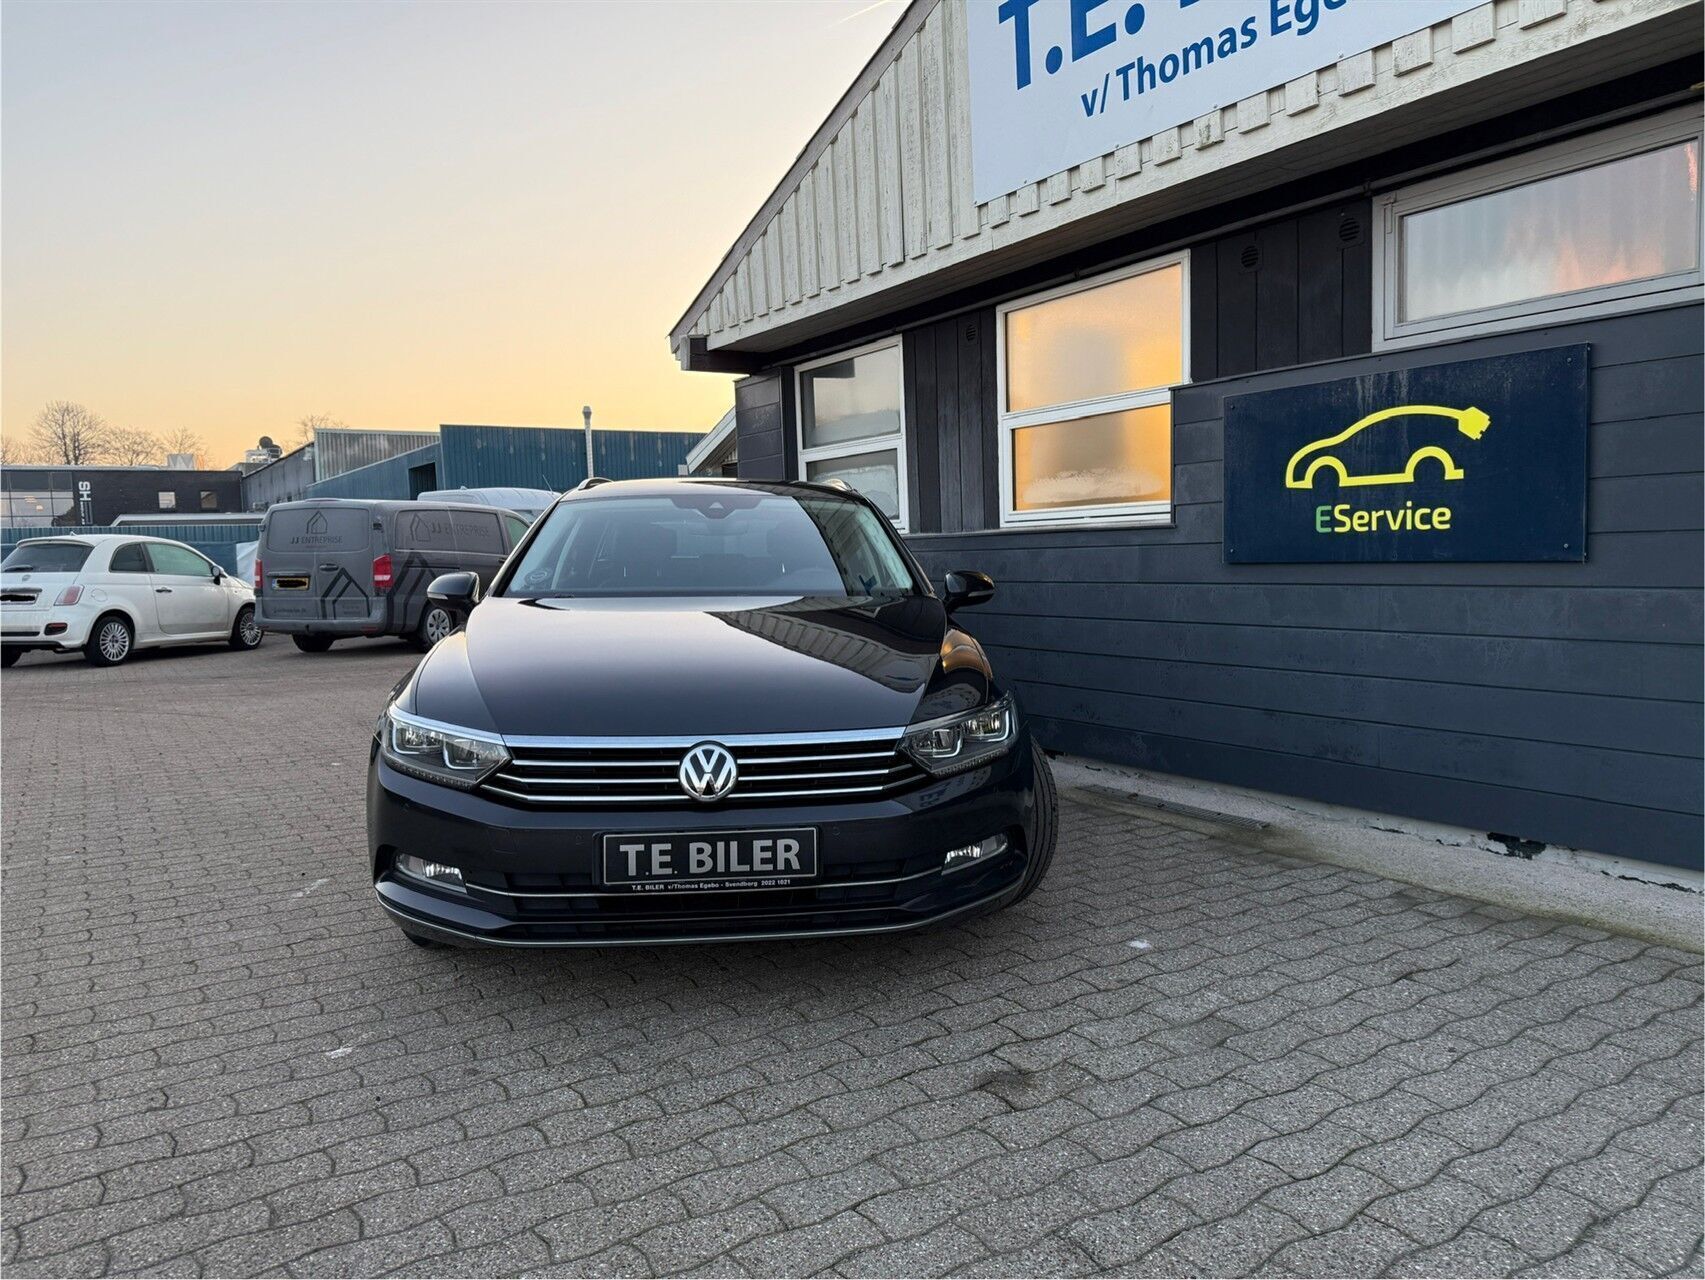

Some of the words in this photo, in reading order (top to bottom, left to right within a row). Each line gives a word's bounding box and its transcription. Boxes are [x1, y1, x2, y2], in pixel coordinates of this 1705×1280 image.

[998, 0, 1145, 90] T.E.
[1116, 16, 1258, 101] Thomas
[1315, 500, 1452, 533] EService
[619, 843, 678, 876] T.E.
[688, 838, 800, 874] BILER
